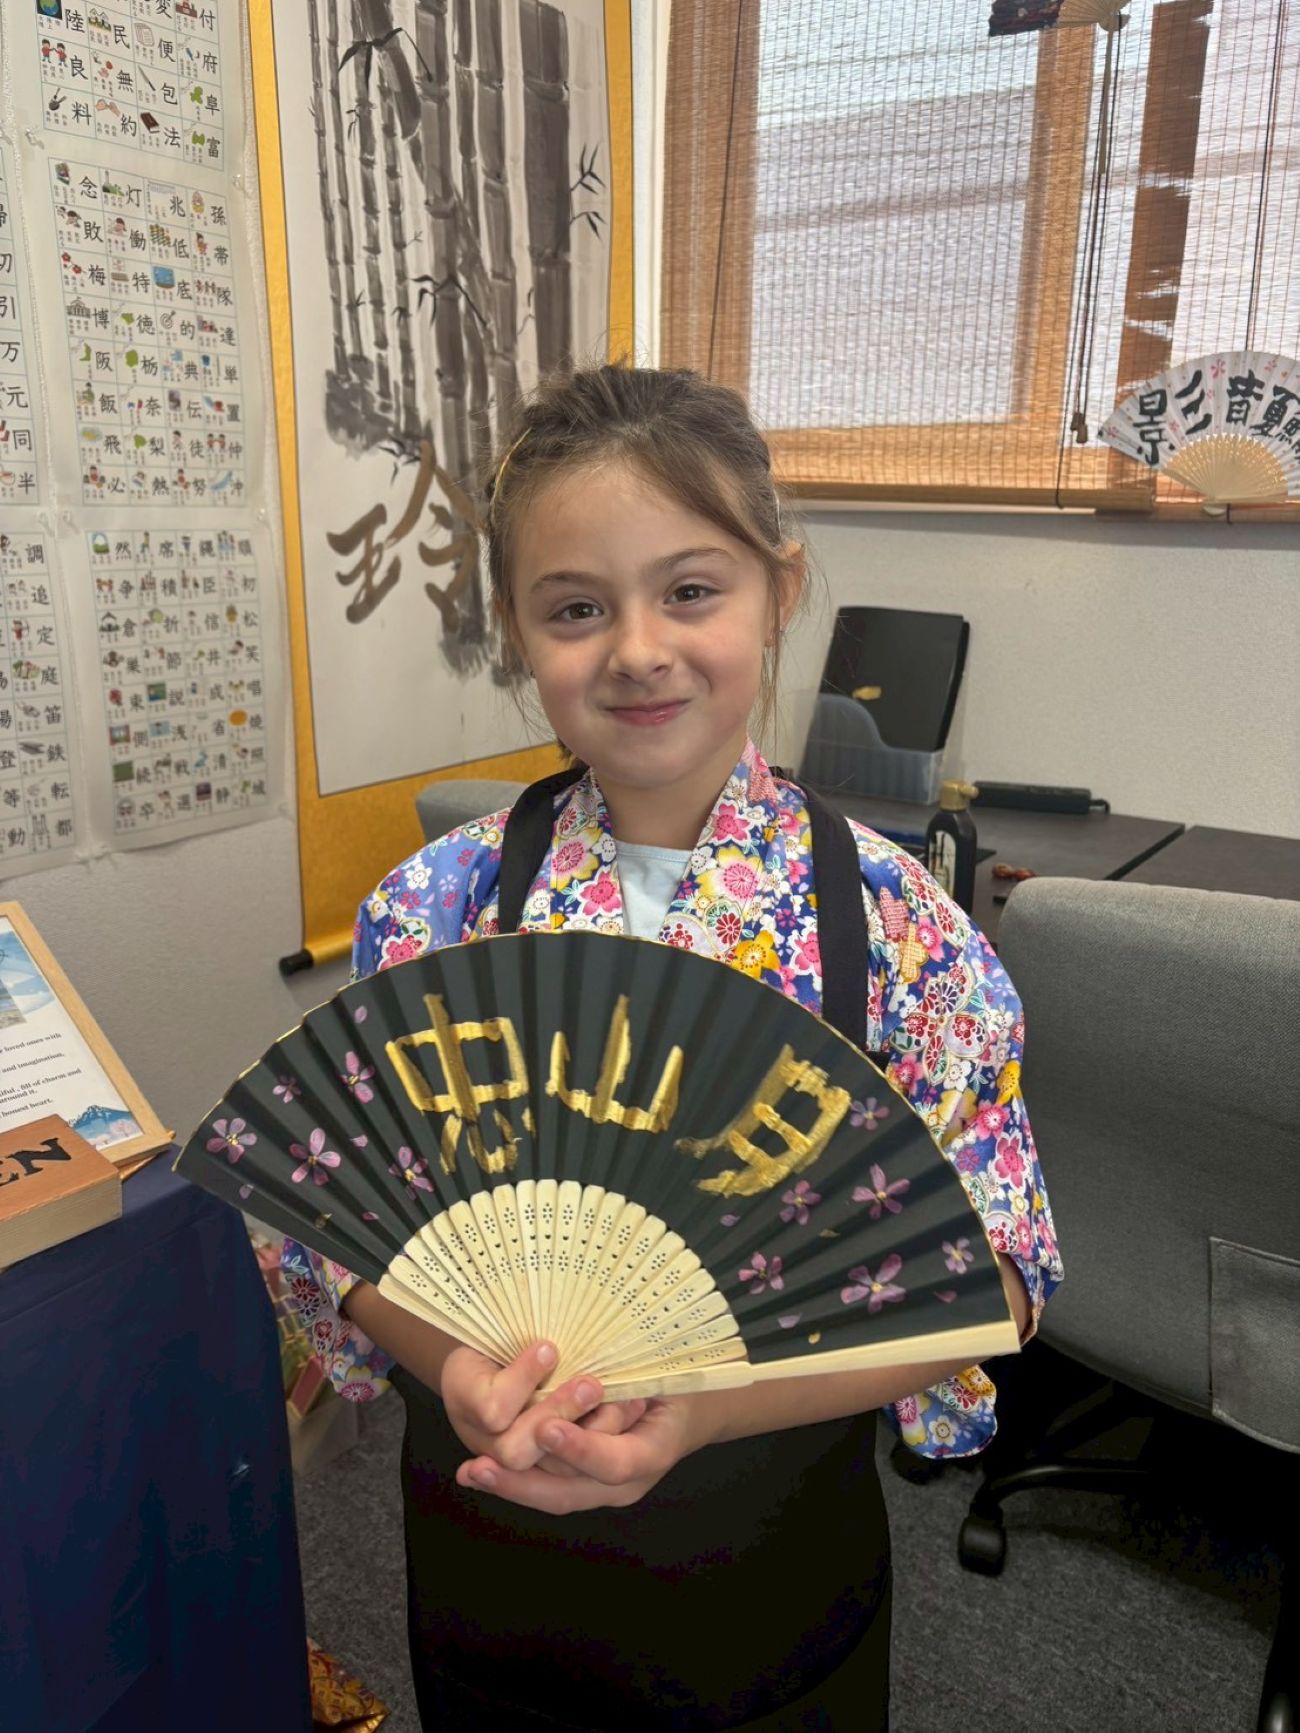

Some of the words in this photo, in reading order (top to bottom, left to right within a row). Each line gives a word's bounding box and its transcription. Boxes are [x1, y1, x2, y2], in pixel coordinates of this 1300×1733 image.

[65, 9, 85, 33] 陸
[199, 9, 216, 31] 付
[113, 25, 130, 49] 民
[158, 39, 175, 62] 便
[70, 55, 88, 79] 良
[203, 52, 217, 74] 府
[117, 70, 133, 92] 無
[161, 83, 178, 105] 包
[72, 102, 92, 125] 料
[205, 94, 220, 115] 阜
[121, 114, 137, 137] 約
[164, 127, 180, 148] 法
[207, 137, 220, 158] 富
[80, 176, 97, 199] 念
[126, 185, 142, 207] 灯
[170, 196, 186, 217] 兆
[211, 206, 226, 225] 孫
[84, 221, 103, 243] 敗
[130, 230, 146, 251] 働
[172, 238, 189, 258] 低
[214, 246, 228, 265] 帯
[89, 265, 106, 286] 梅
[132, 272, 150, 293] 特
[177, 280, 193, 300] 底
[214, 284, 233, 306] 隊
[92, 308, 109, 329] 博
[137, 315, 155, 335] 徳
[180, 320, 195, 340] 的
[220, 327, 235, 346] 達
[0, 341, 20, 362] 万
[96, 351, 113, 371] 阪
[141, 356, 158, 376] 栃
[185, 362, 198, 380] 典
[224, 366, 238, 383] 単
[6, 386, 28, 408] 元
[99, 394, 117, 414] 飯
[145, 397, 161, 416] 奈
[187, 401, 202, 419] 伝
[12, 429, 32, 451] 同
[104, 435, 121, 454] 飛
[149, 437, 165, 455] 梨
[190, 440, 204, 458] 徒
[18, 472, 35, 494] 半
[107, 477, 125, 493] 必
[25, 544, 44, 563] 調
[116, 542, 131, 559] 然
[32, 585, 50, 605] 追
[119, 580, 134, 599] 争
[203, 577, 216, 594] 臣
[205, 613, 219, 630] 信
[243, 611, 258, 627] 松
[37, 626, 55, 645] 定
[41, 666, 59, 685] 庭
[45, 705, 61, 724] 笛
[47, 744, 66, 762] 鉄
[51, 783, 69, 799] 転
[8, 828, 25, 846] 動
[45, 1032, 62, 1040] with
[2, 1064, 17, 1073] and
[67, 1068, 82, 1076] and
